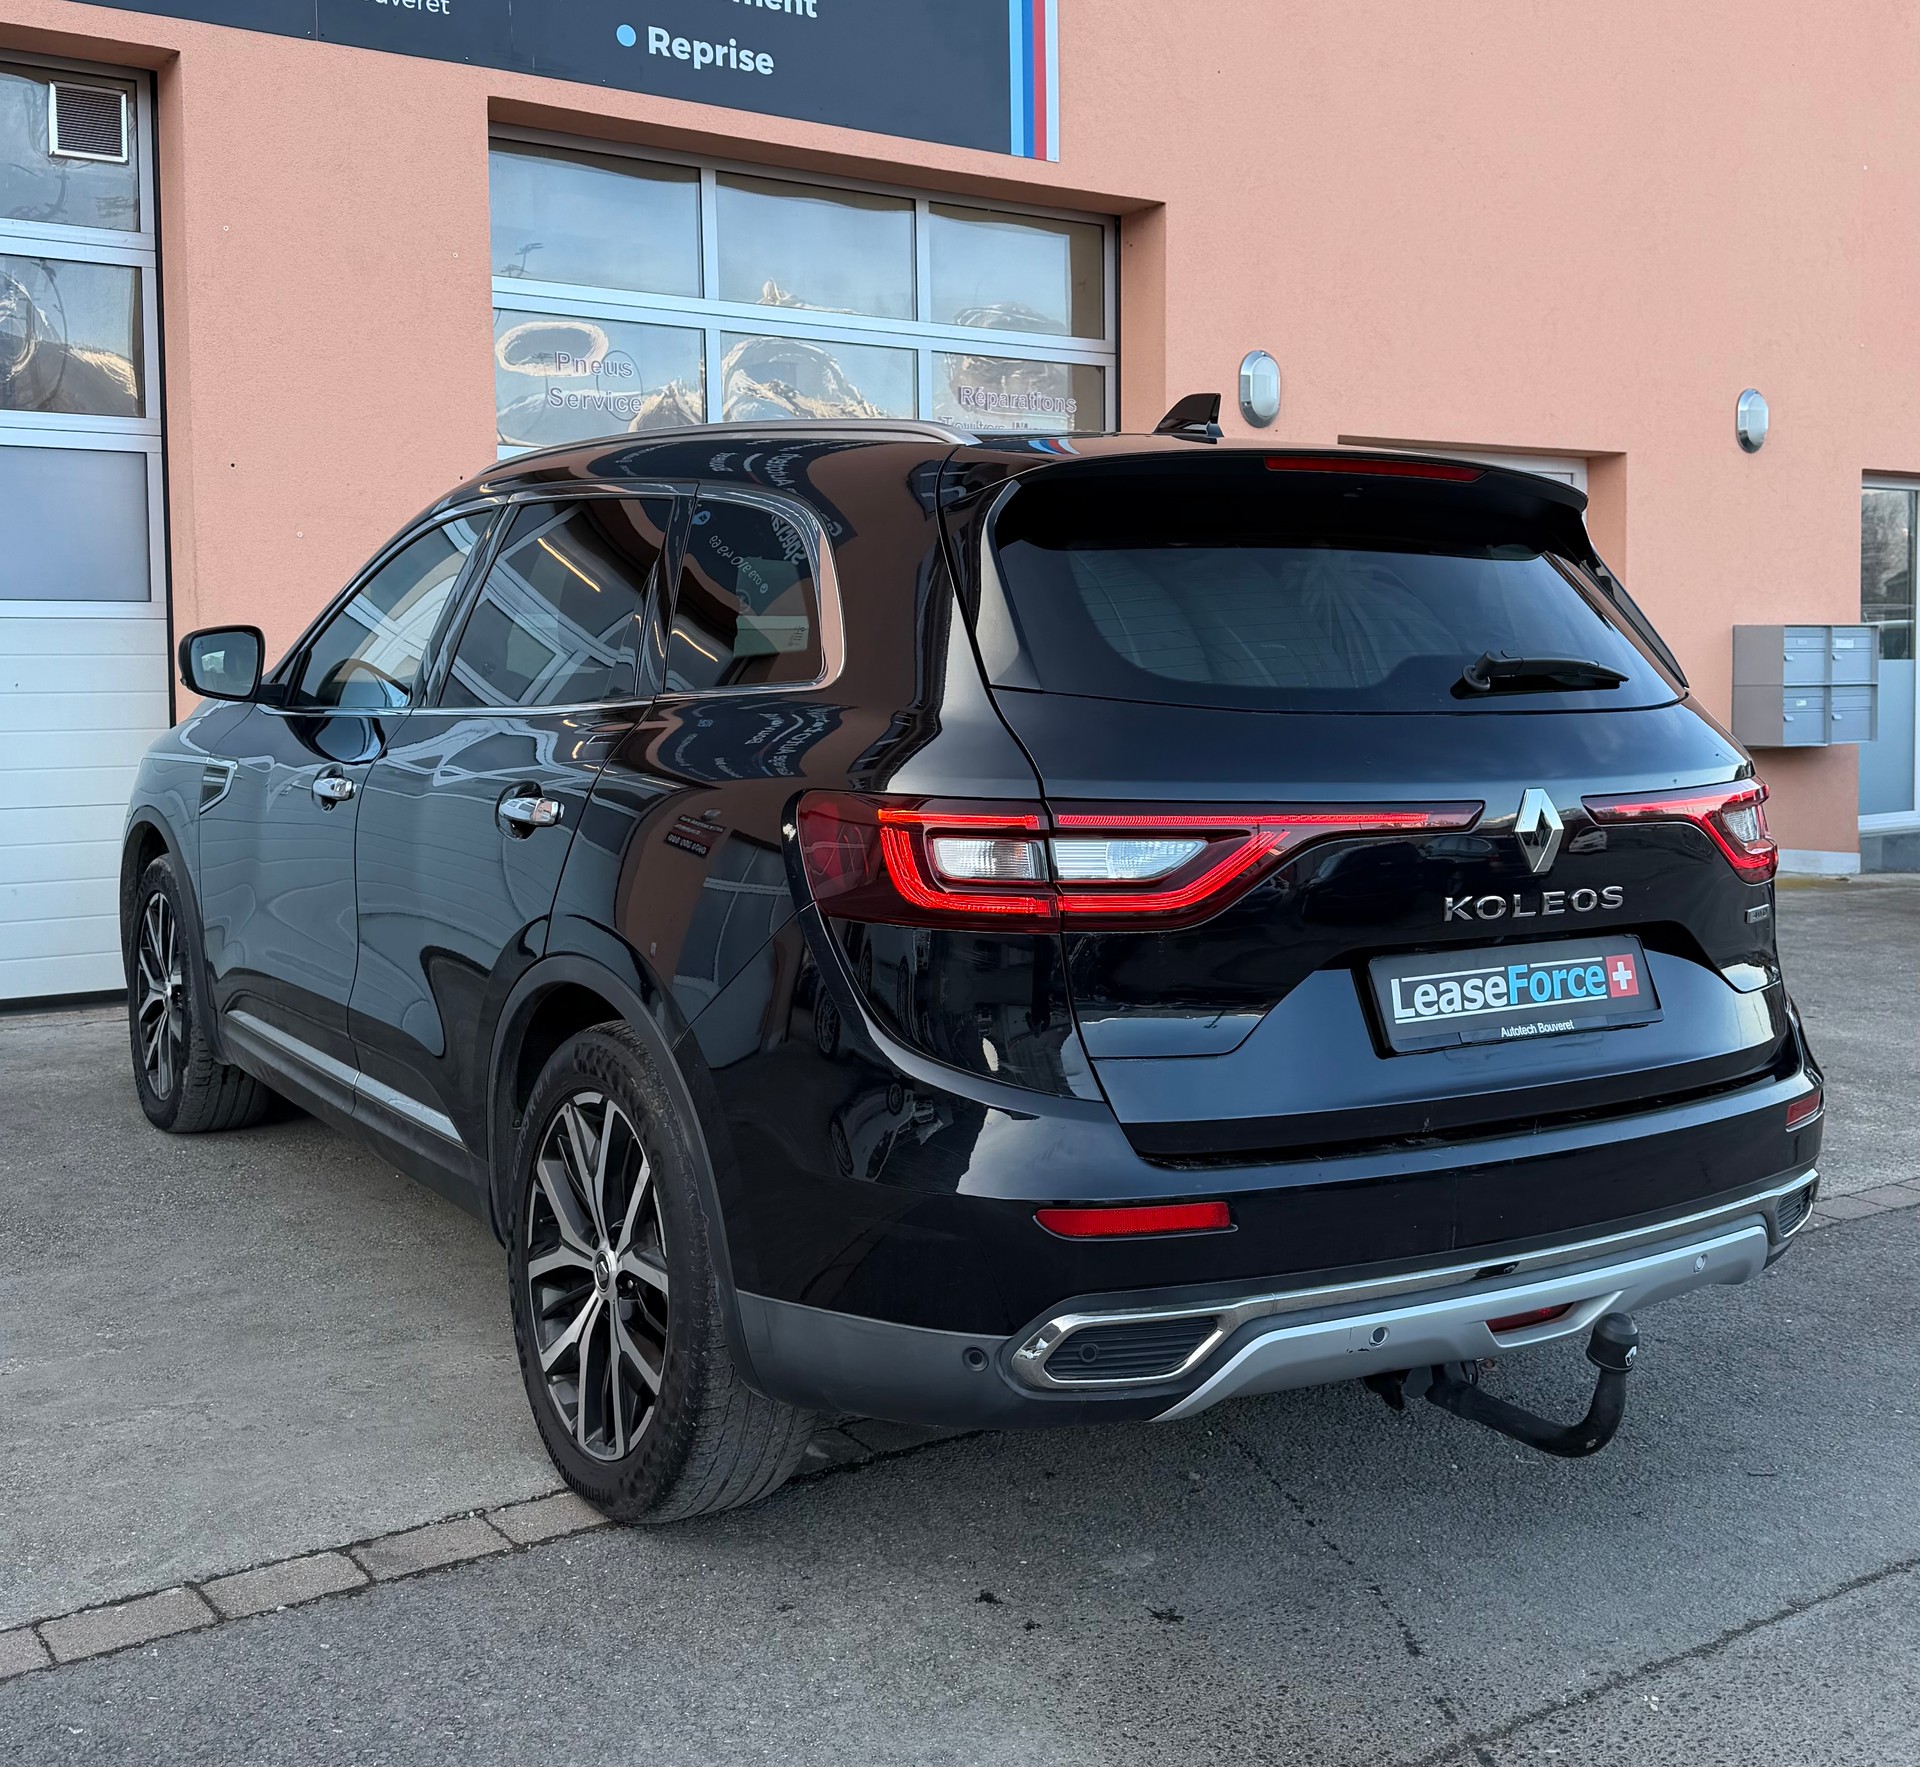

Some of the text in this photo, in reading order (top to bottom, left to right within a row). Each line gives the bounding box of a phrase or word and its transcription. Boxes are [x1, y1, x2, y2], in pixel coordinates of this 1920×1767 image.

[647, 25, 775, 75] Reprise
[554, 351, 634, 378] Pneus
[548, 386, 643, 413] Service
[958, 385, 1078, 414] Réparations
[1443, 885, 1625, 923] KOLEOS
[1390, 963, 1607, 1019] LeaseForce
[1501, 1019, 1575, 1039] Autotech Bouveret
